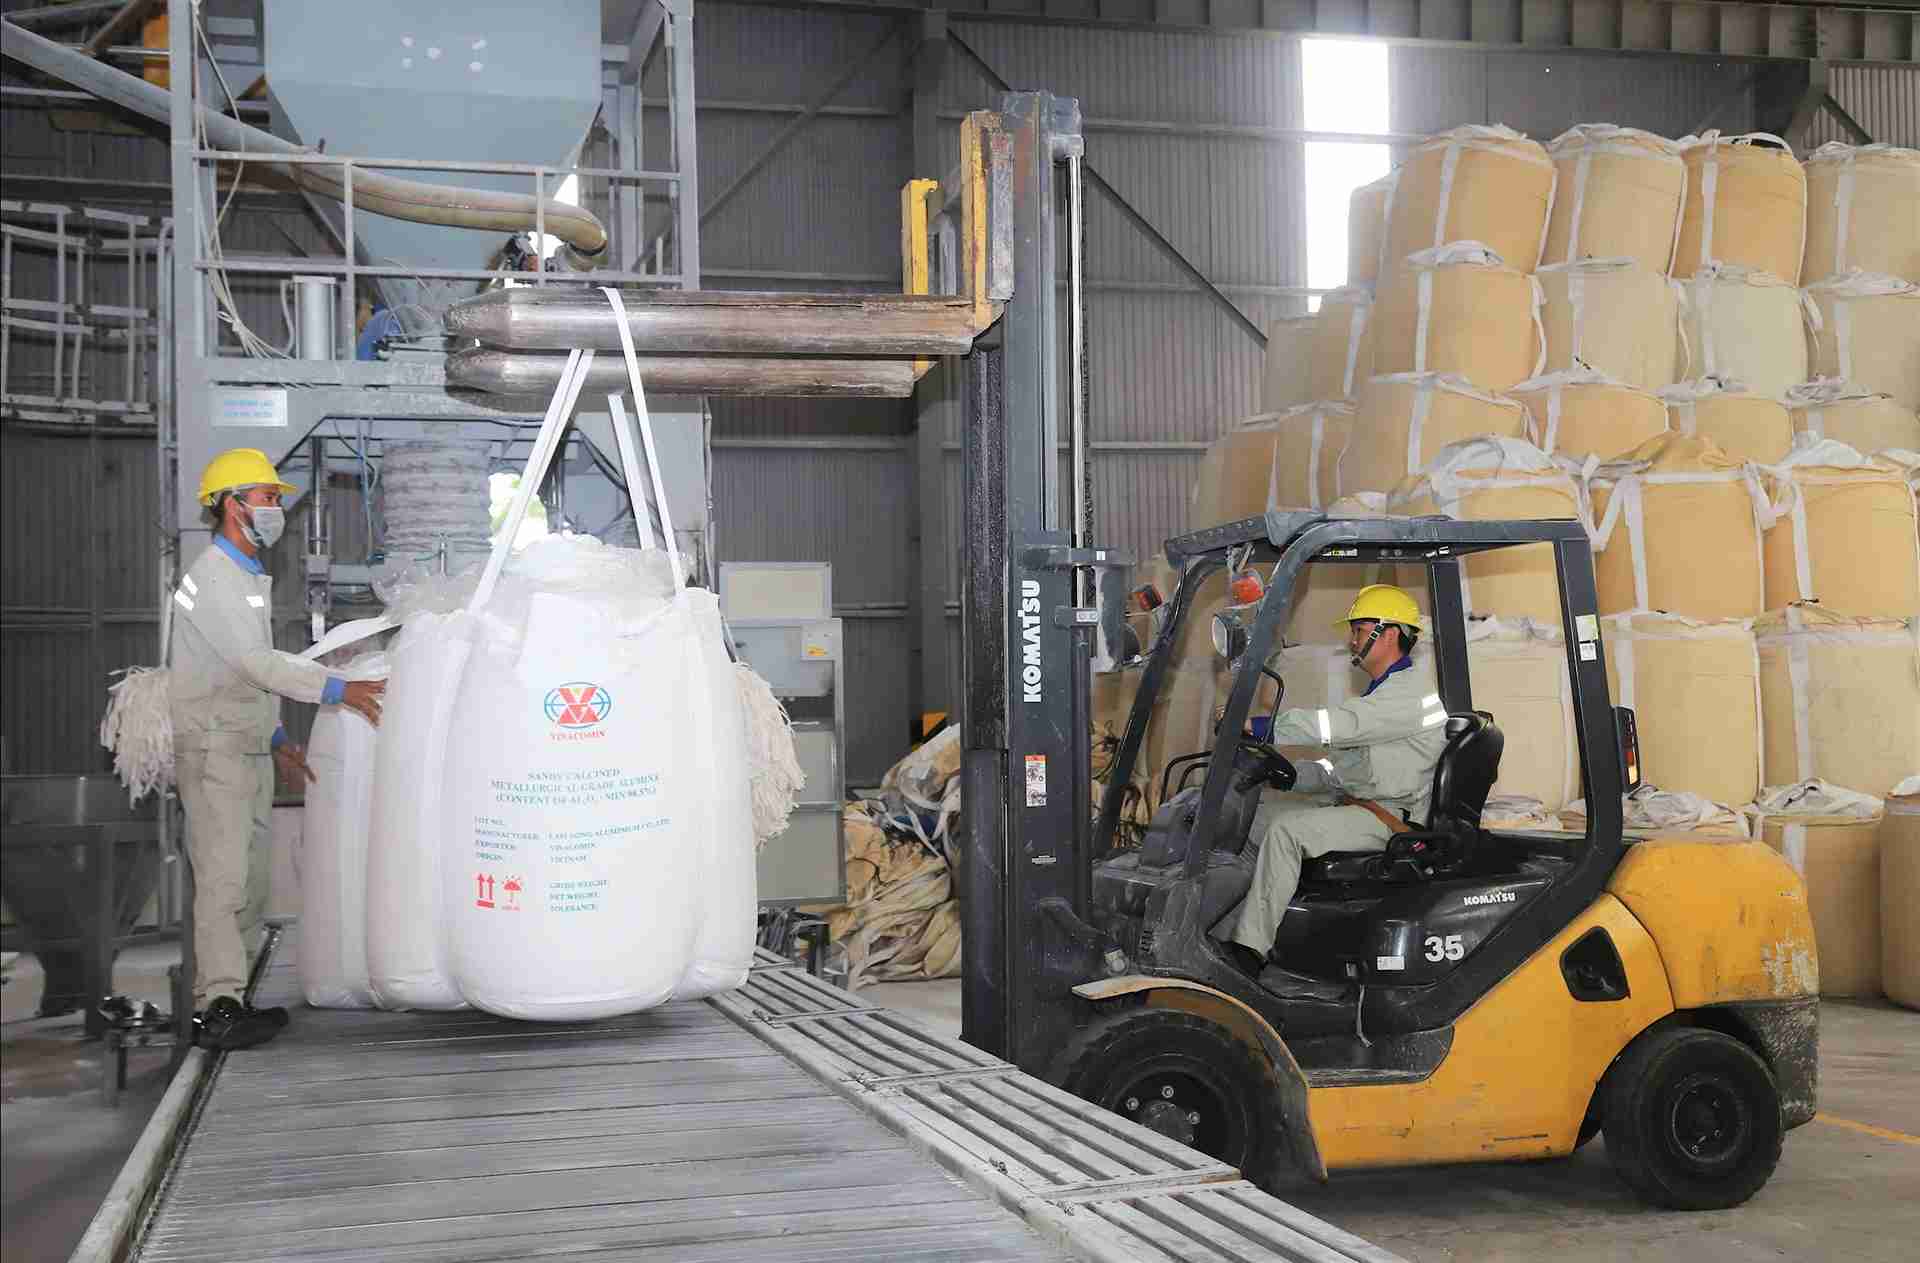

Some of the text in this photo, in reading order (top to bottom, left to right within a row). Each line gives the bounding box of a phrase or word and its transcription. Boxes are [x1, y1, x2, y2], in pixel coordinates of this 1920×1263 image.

[1017, 580, 1042, 702] KOMATSU
[1463, 892, 1516, 906] KOMATSU
[1424, 935, 1465, 962] 35
